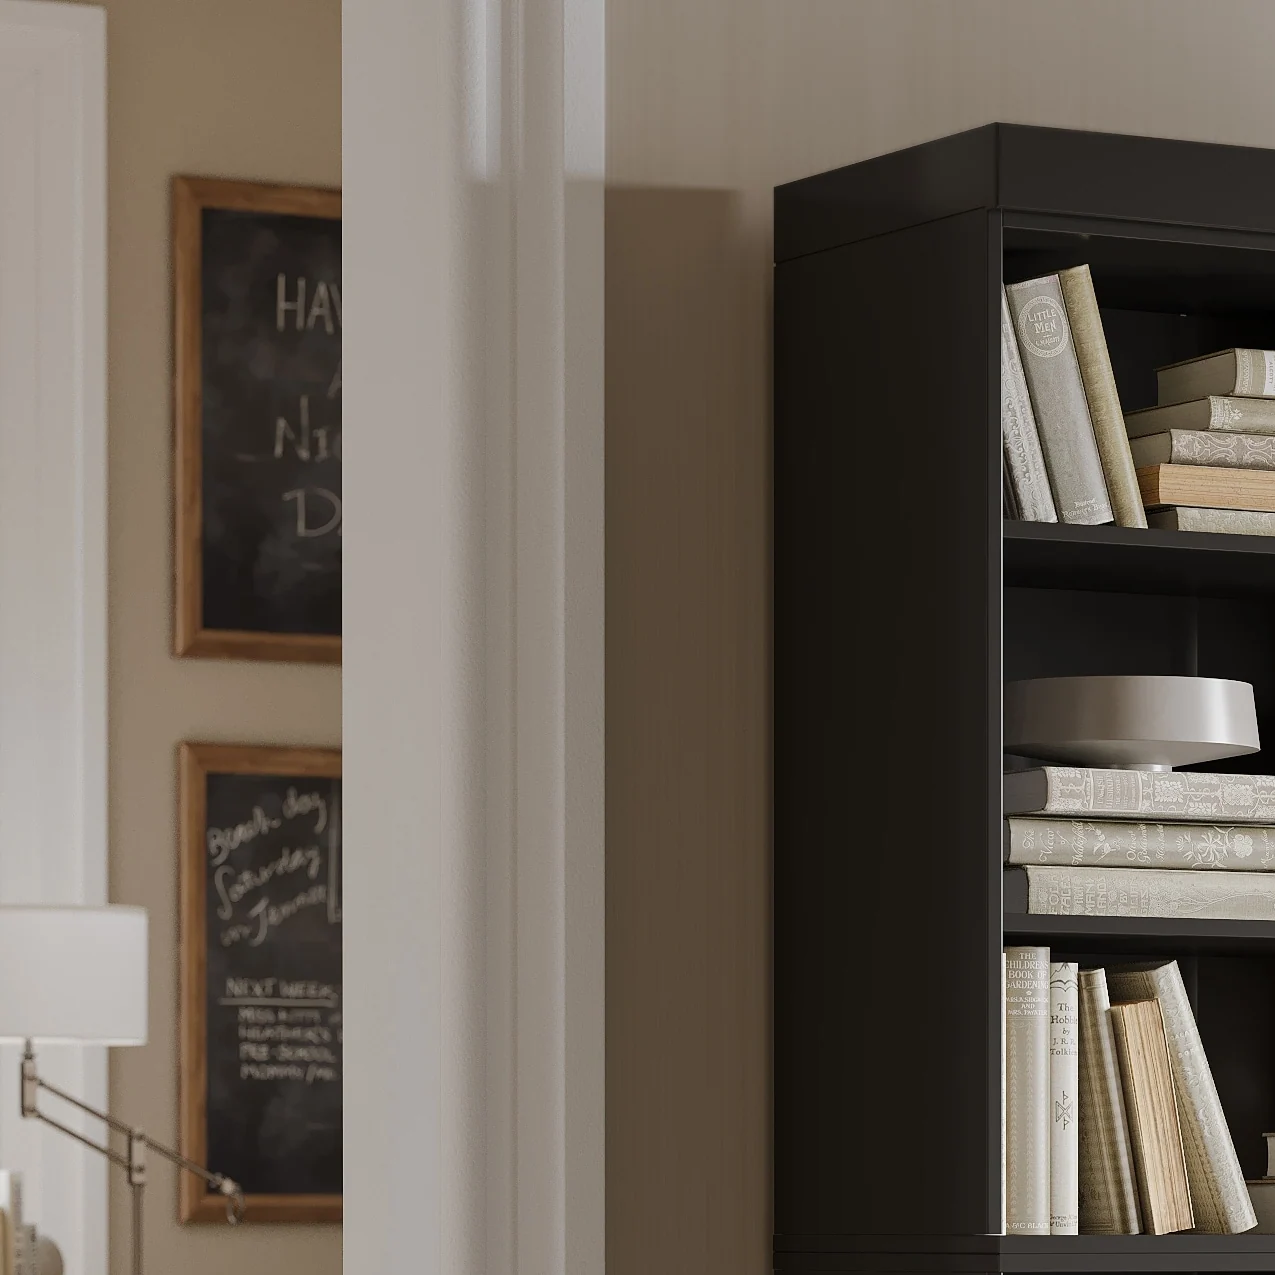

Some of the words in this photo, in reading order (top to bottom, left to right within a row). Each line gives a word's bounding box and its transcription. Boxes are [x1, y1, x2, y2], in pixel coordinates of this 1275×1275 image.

[1027, 308, 1057, 322] LITTLE
[1034, 320, 1057, 334] MEN
[1038, 827, 1055, 862] Vicar
[1127, 831, 1137, 861] Oliver
[1118, 889, 1129, 904] BY
[1019, 952, 1037, 960] THE
[1008, 970, 1033, 980] BOOK
[1036, 970, 1048, 980] OF
[1005, 980, 1049, 990] GARDENING
[1057, 1003, 1075, 1012] The
[1062, 1028, 1071, 1036] by
